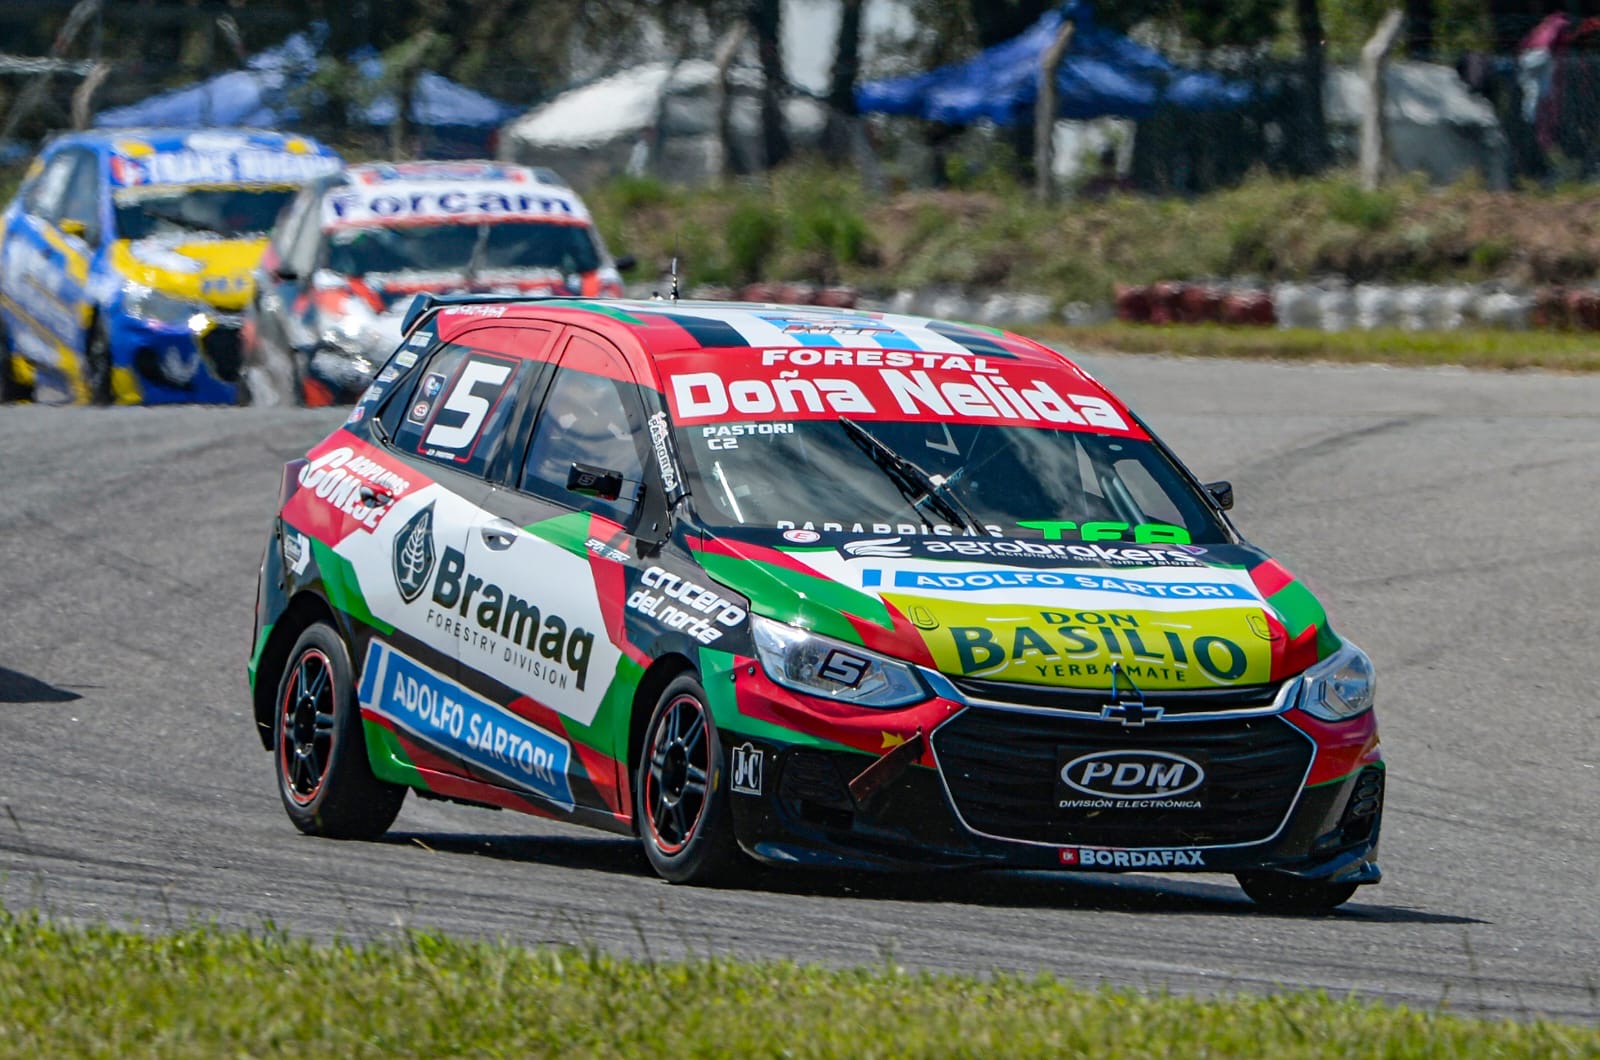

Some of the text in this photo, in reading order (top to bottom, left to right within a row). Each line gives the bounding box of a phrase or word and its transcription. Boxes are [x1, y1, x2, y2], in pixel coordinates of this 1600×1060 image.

[332, 191, 572, 218] Forcam
[762, 349, 1000, 374] FORESTAL
[426, 360, 512, 449] 5
[670, 368, 1130, 431] Doña Nelida
[702, 423, 794, 438] PASTORI
[707, 438, 739, 451] C2
[922, 540, 1197, 562] agrobrokers
[640, 566, 747, 627] crucero
[917, 573, 1235, 597] ADOLFO SARTORI
[432, 545, 594, 692] Bramaq
[626, 590, 724, 645] del norte
[1040, 611, 1141, 628] DON
[426, 608, 567, 690] FORESTRY DIVISION
[948, 626, 1248, 681] BASILIO
[823, 652, 866, 686] 5
[1035, 663, 1187, 682] YERBA MATE
[392, 671, 556, 786] ADOLFO SARTORI
[1080, 762, 1186, 787] PDM
[1059, 798, 1114, 808] DIVISIÓN
[1079, 849, 1206, 867] BORDAFAX
